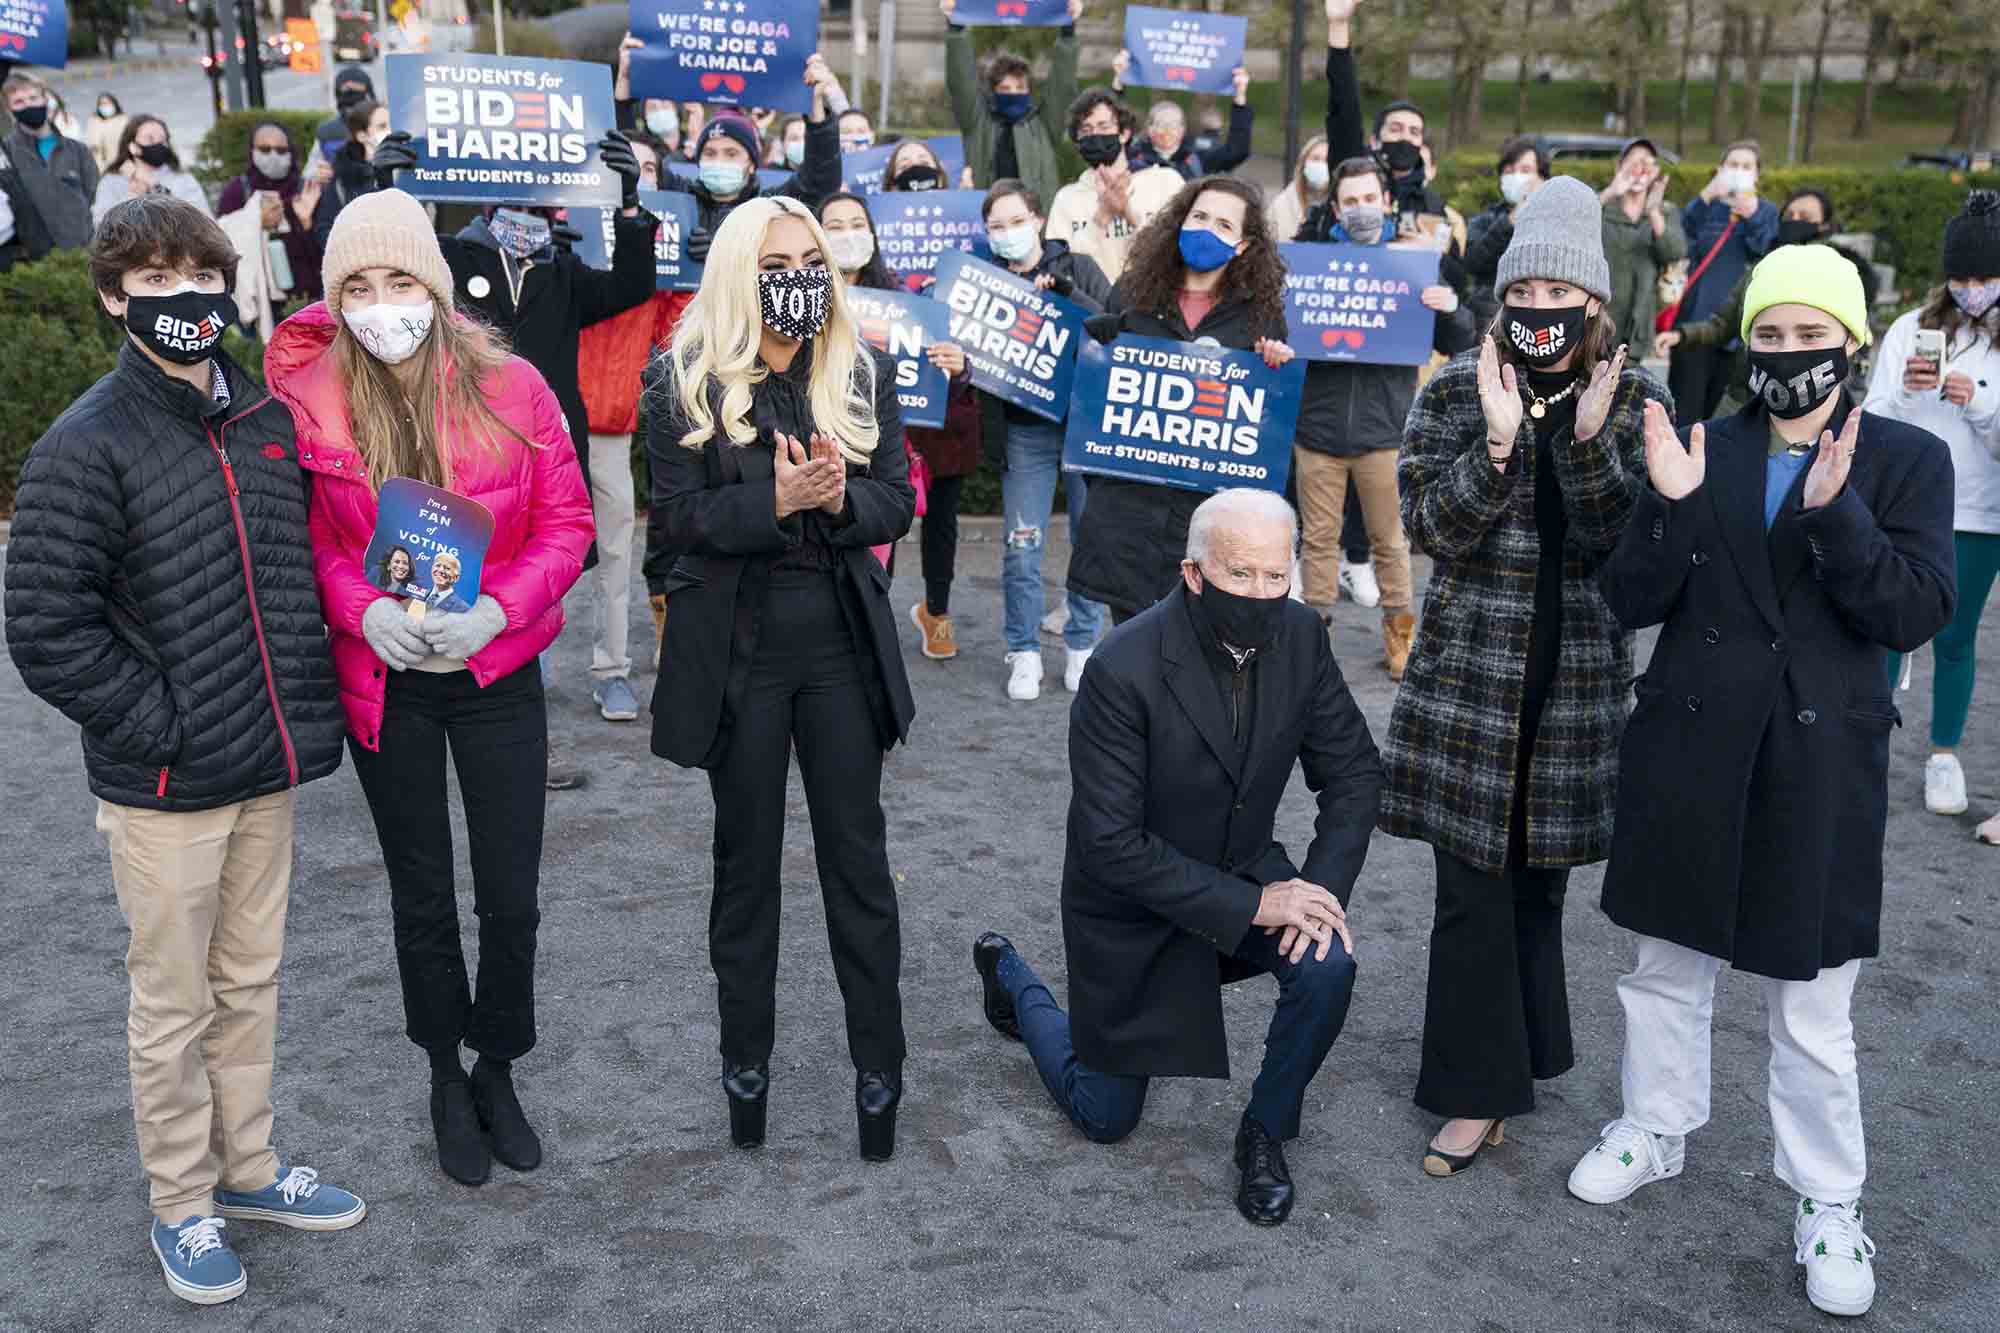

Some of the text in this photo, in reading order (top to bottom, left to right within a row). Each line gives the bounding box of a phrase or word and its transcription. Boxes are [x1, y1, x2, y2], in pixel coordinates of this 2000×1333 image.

[657, 13, 790, 39] WE'RE GAGA
[669, 33, 777, 56] FOR JOE &
[679, 53, 768, 73] KAMALA
[423, 66, 563, 91] STUDENTS for
[424, 87, 585, 130] BIDEN
[426, 127, 587, 164] HARRIS
[414, 168, 601, 186] Text STUDENTS to 30330
[930, 222, 982, 236] GAGA
[960, 238, 973, 252] &
[885, 256, 939, 271] KAM
[959, 263, 1063, 320] STUDENTS for
[1284, 273, 1410, 295] WE'RE GAGA
[769, 284, 826, 321] VOTE
[1295, 292, 1397, 313] FOR JOE &
[154, 310, 225, 340] BIDEN
[949, 279, 1070, 358] BIDEN
[1302, 311, 1387, 329] KAMALA
[1510, 320, 1565, 346] BIDEN
[1112, 346, 1250, 381] STUDENTS for
[1017, 376, 1056, 403] 30330
[1106, 366, 1265, 425] BIDEN
[1748, 359, 1840, 411] VOTE
[1101, 405, 1259, 456] HARRIS
[1085, 441, 1113, 457] Text
[1114, 445, 1200, 470] STUDENTS
[1201, 460, 1216, 472] to
[1217, 461, 1267, 480] 30330
[427, 497, 441, 509] I'm
[418, 508, 451, 527] FAN
[399, 529, 459, 557] VOTING
[426, 526, 438, 536] of
[415, 552, 431, 561] for
